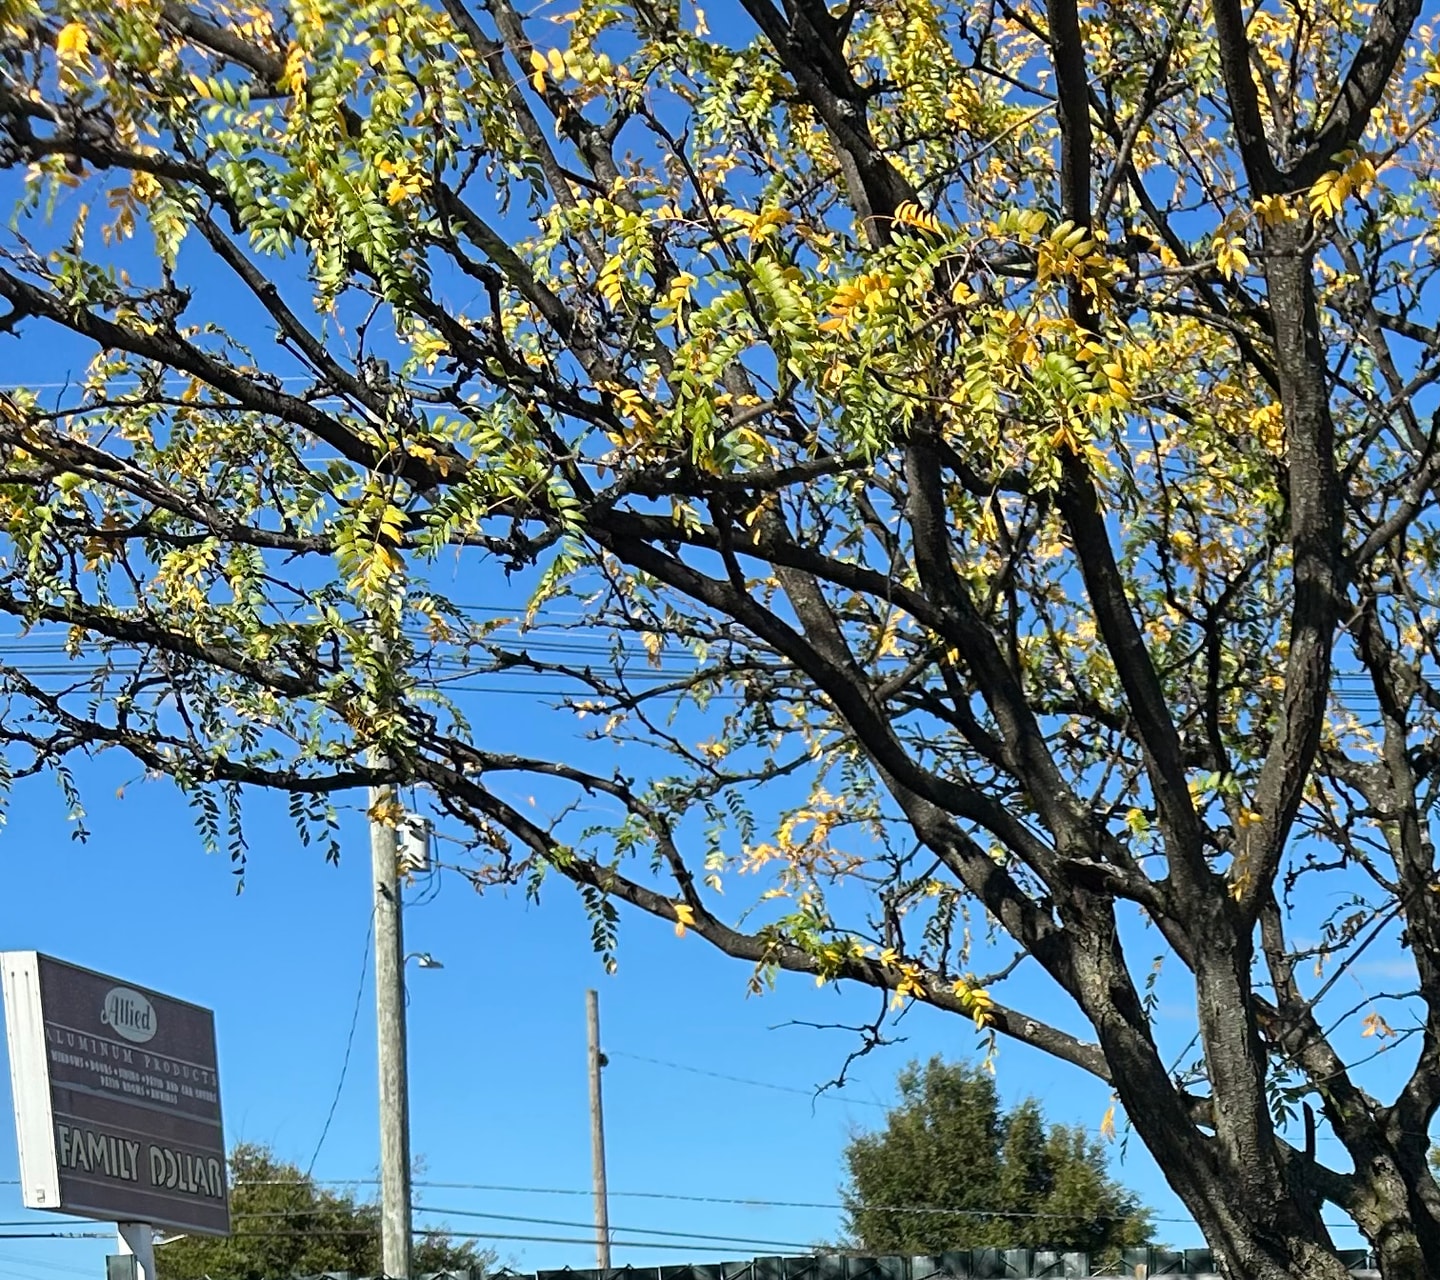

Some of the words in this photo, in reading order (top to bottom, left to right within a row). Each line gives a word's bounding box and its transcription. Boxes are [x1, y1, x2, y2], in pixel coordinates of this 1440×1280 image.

[102, 994, 153, 1032] Allied
[46, 1027, 133, 1065] ALUMINUM
[144, 1055, 217, 1086] PRODUCTS
[57, 1123, 141, 1182] FAMILY
[150, 1145, 224, 1199] DOLLAR
